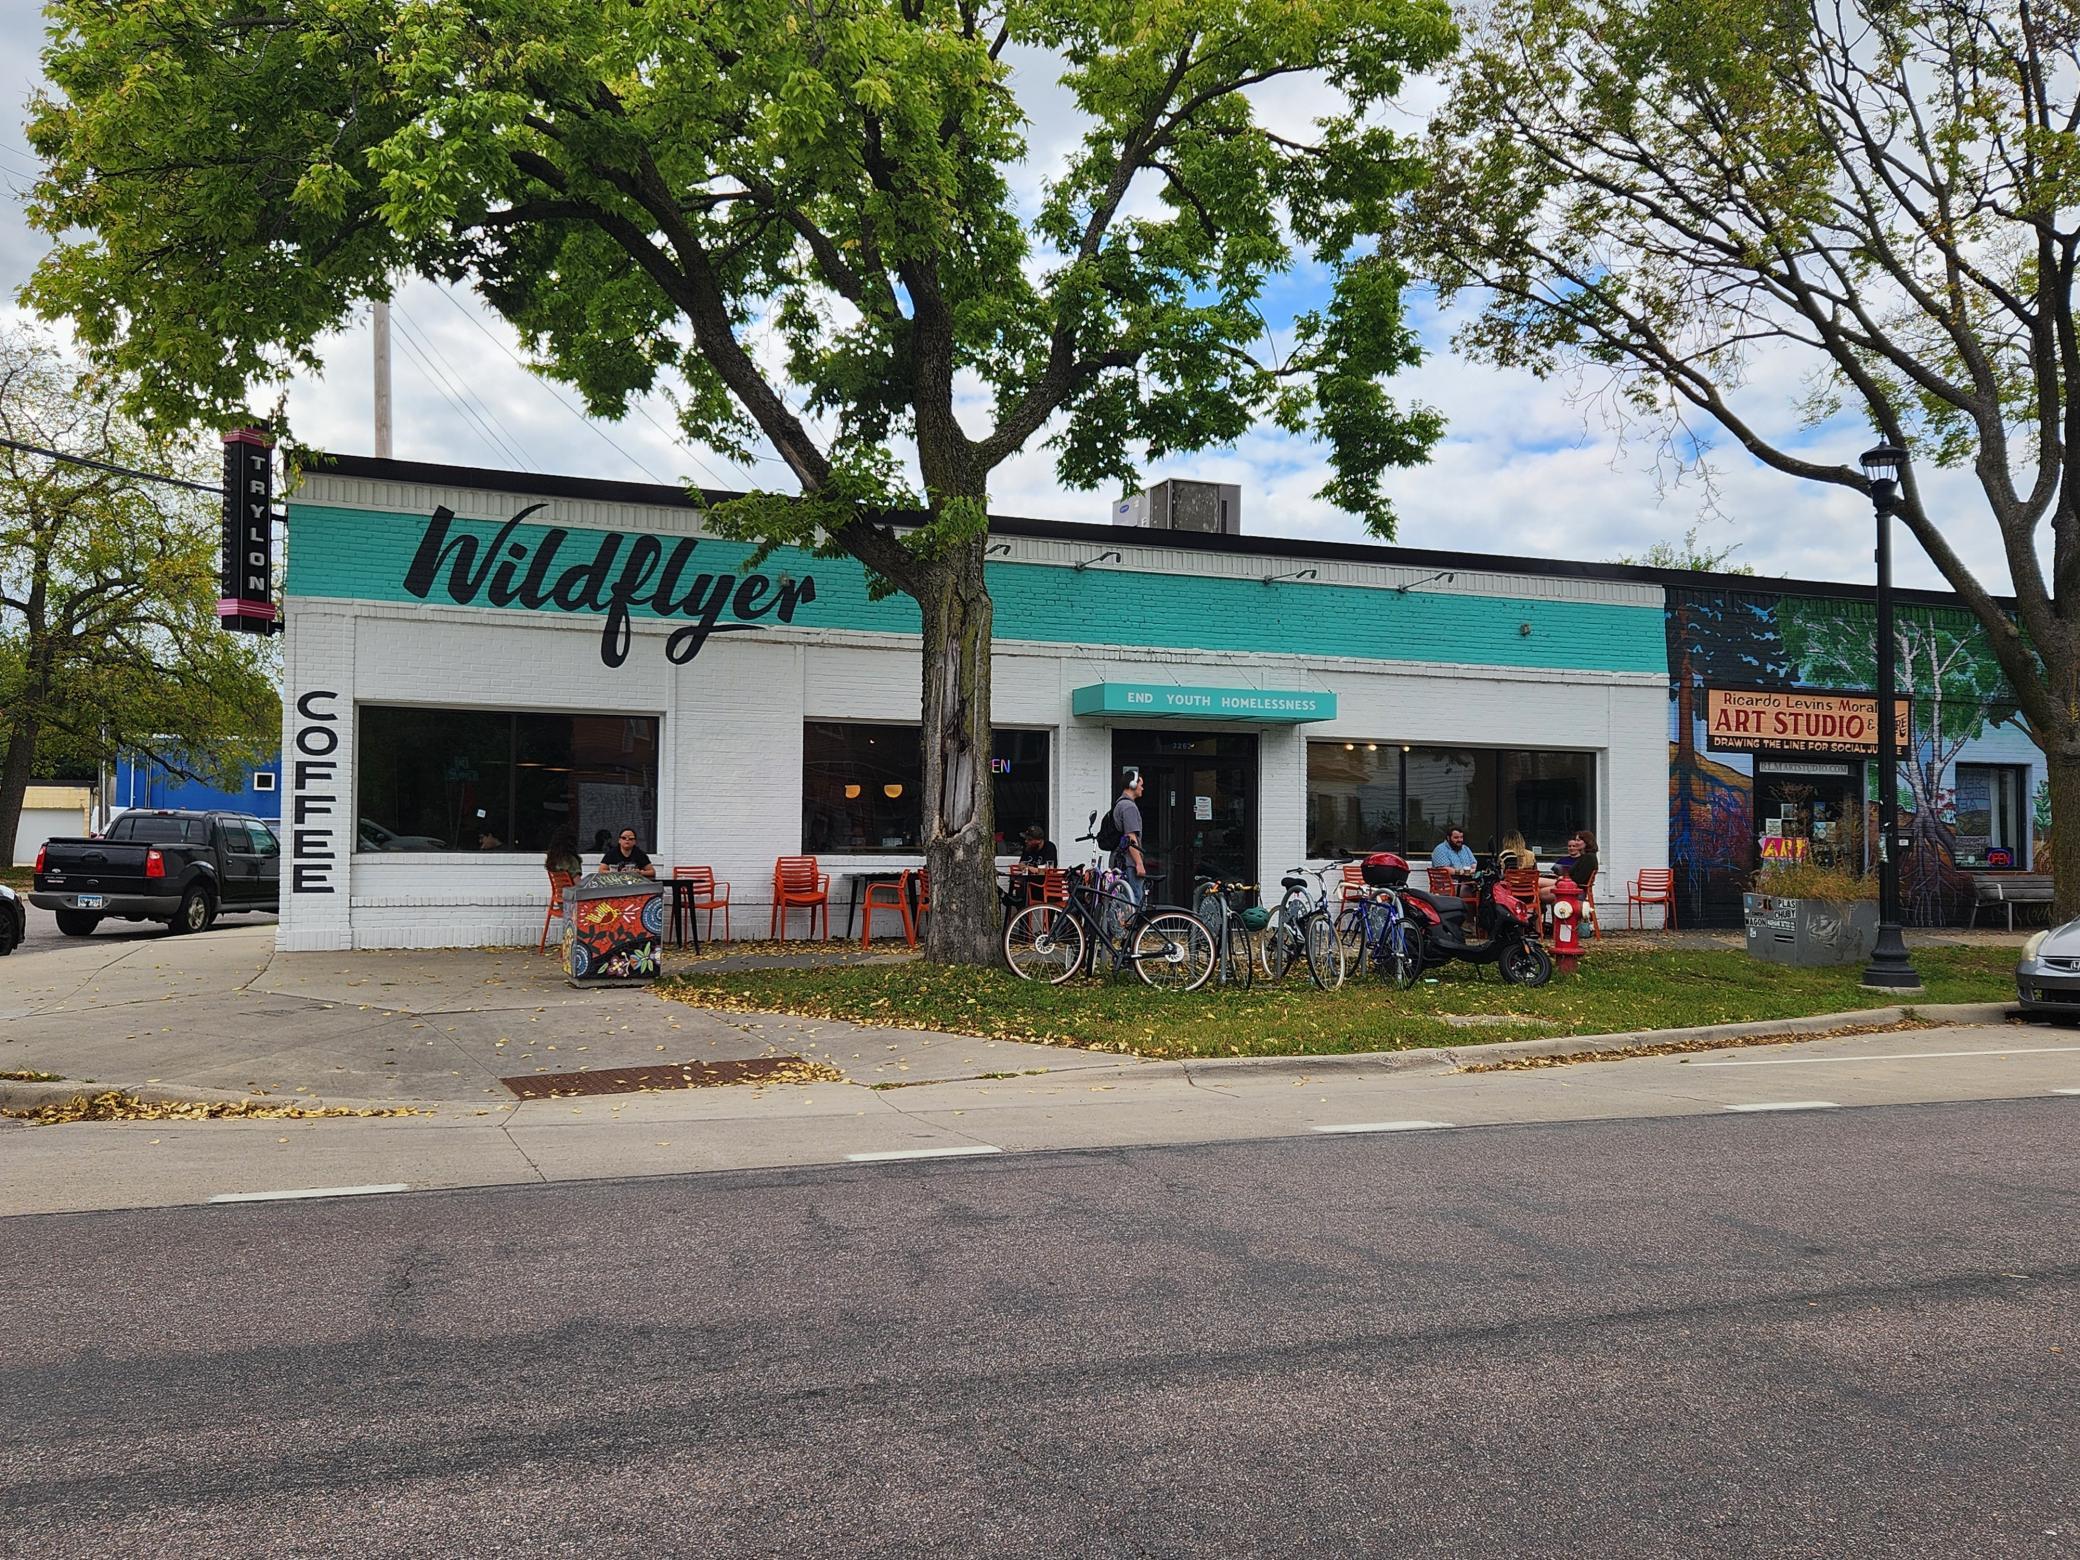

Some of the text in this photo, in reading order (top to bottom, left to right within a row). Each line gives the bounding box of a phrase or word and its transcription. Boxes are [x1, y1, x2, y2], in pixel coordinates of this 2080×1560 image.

[248, 455, 266, 592] TRYLON
[402, 503, 816, 669] Wildflyer
[1127, 692, 1316, 711] END YOUTH HOMELESSNESS
[1723, 692, 1878, 714] Ricardo Levins Moral
[1714, 708, 1766, 734] ART
[1773, 711, 1865, 739] STUDIO
[1867, 719, 1876, 730] &
[1714, 737, 1760, 749] DRAWING
[1763, 739, 1781, 749] THE
[1783, 740, 1806, 750] LINE
[1808, 741, 1828, 752] FOR
[1831, 743, 1866, 753] SOCIAL
[991, 758, 1011, 774] EN
[293, 690, 339, 894] COFFEE
